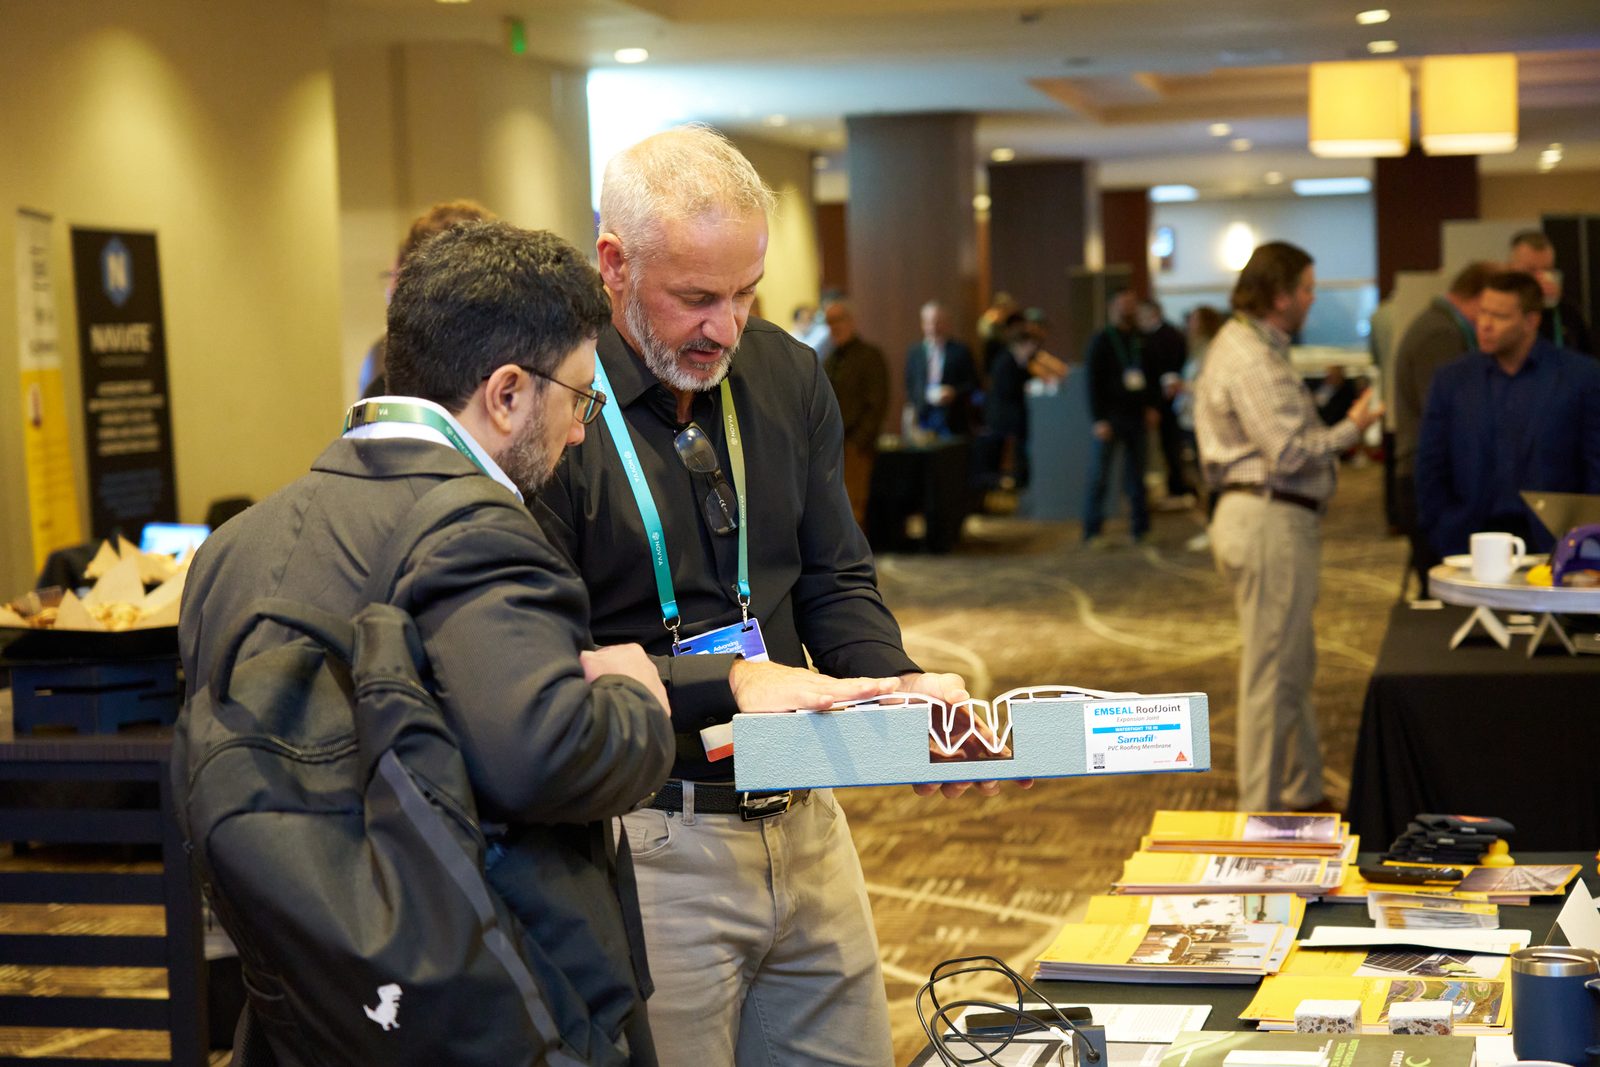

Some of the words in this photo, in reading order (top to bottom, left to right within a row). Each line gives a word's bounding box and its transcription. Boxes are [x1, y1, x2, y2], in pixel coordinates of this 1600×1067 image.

[655, 541, 664, 566] NOVVA
[1094, 706, 1134, 716] EMSEAL
[1136, 704, 1181, 714] RoofJoint
[1117, 734, 1154, 744] Sarnafil
